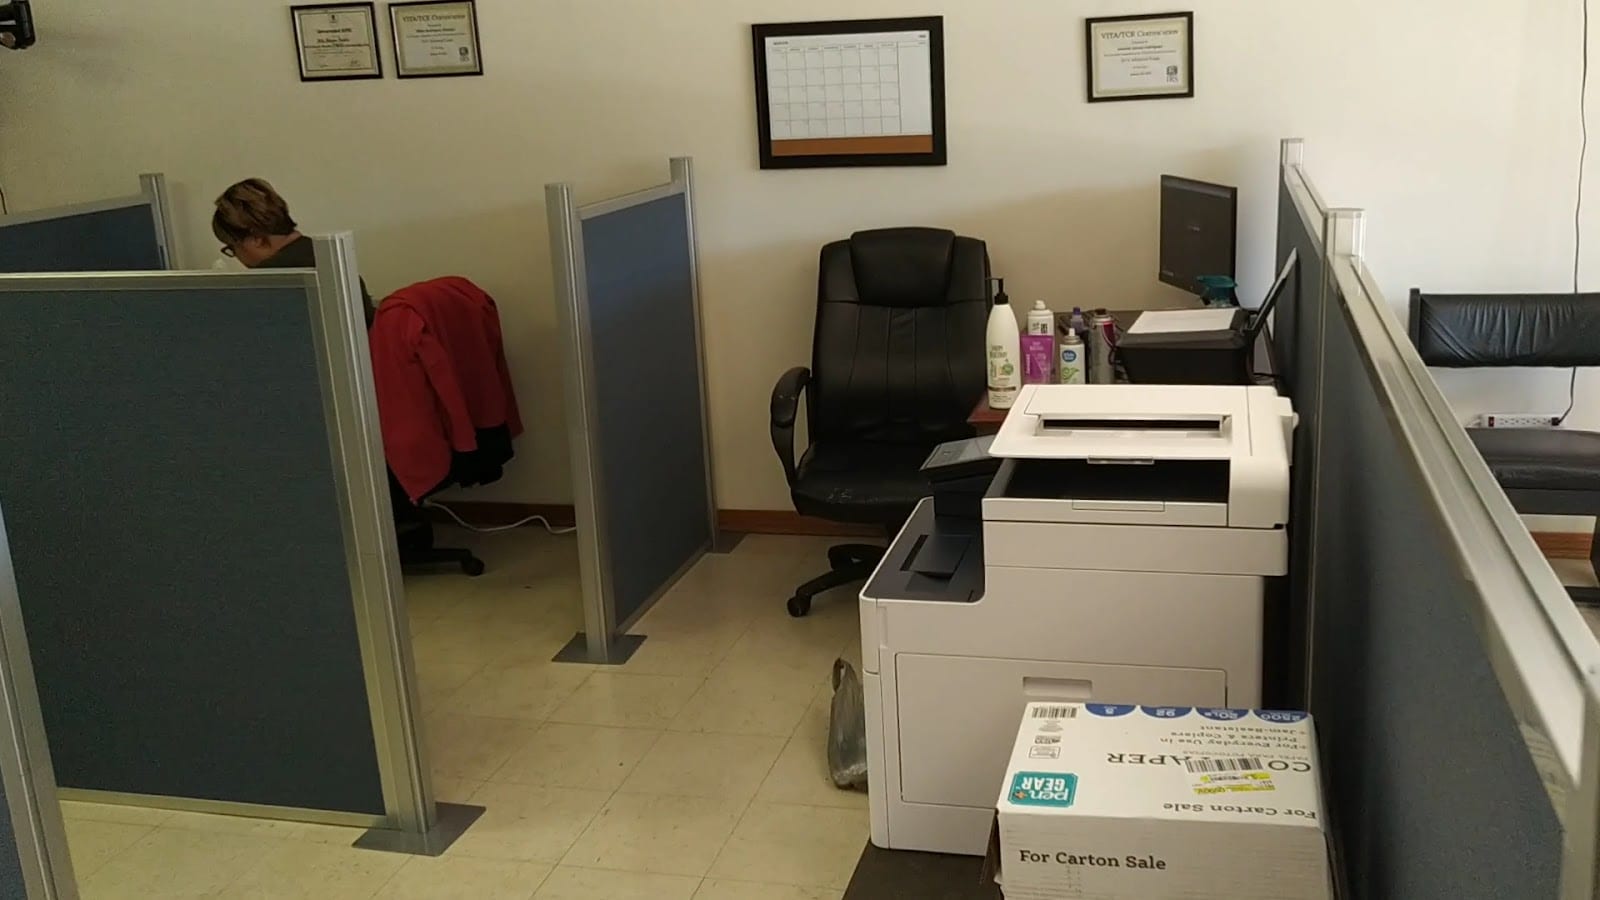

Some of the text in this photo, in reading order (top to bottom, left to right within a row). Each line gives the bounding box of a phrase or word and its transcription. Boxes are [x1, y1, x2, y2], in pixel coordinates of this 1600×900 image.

[1156, 709, 1176, 717] 92
[1208, 739, 1270, 748] Everyday
[1241, 734, 1297, 743] Printers
[1107, 753, 1210, 766] APER
[1021, 777, 1067, 792] GEAR
[1163, 803, 1317, 820] For Carton Sale
[1020, 850, 1166, 870] For Carton Sale
